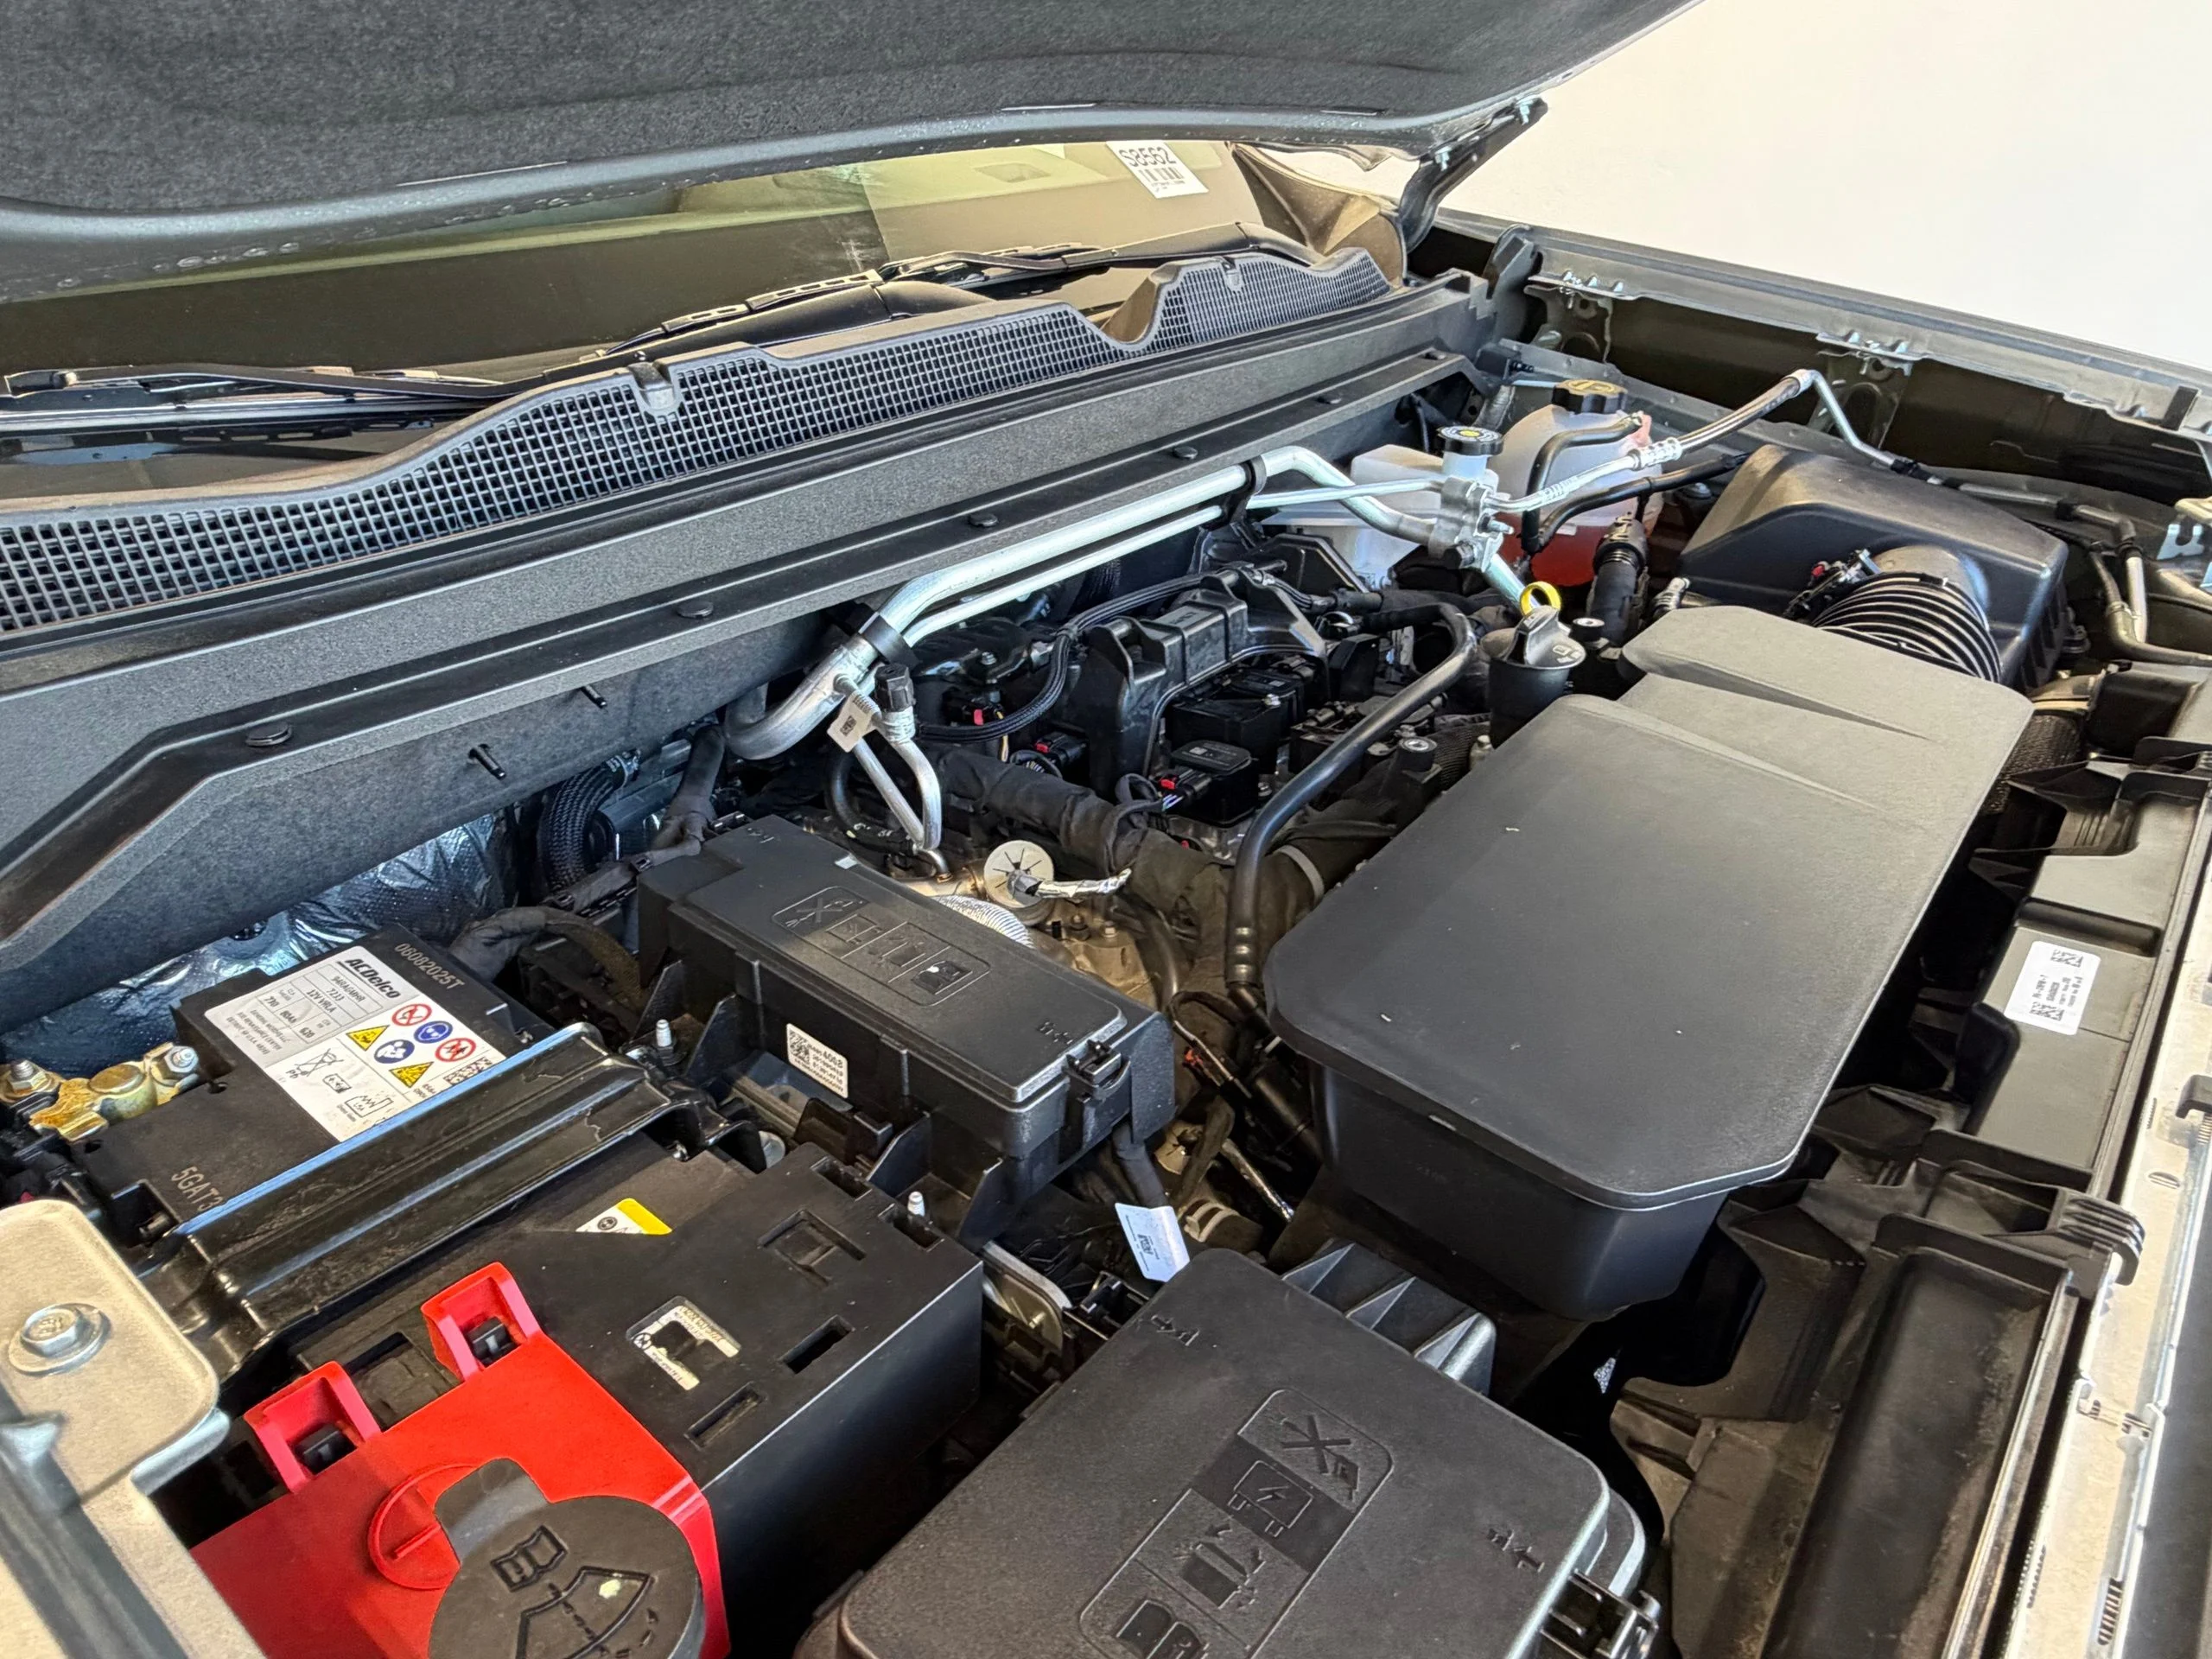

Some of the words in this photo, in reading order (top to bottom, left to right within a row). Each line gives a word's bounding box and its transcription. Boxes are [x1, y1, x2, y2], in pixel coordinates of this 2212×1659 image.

[1118, 146, 1177, 168] S8562
[345, 958, 401, 999] ACDelco
[394, 943, 466, 990] 06082025T
